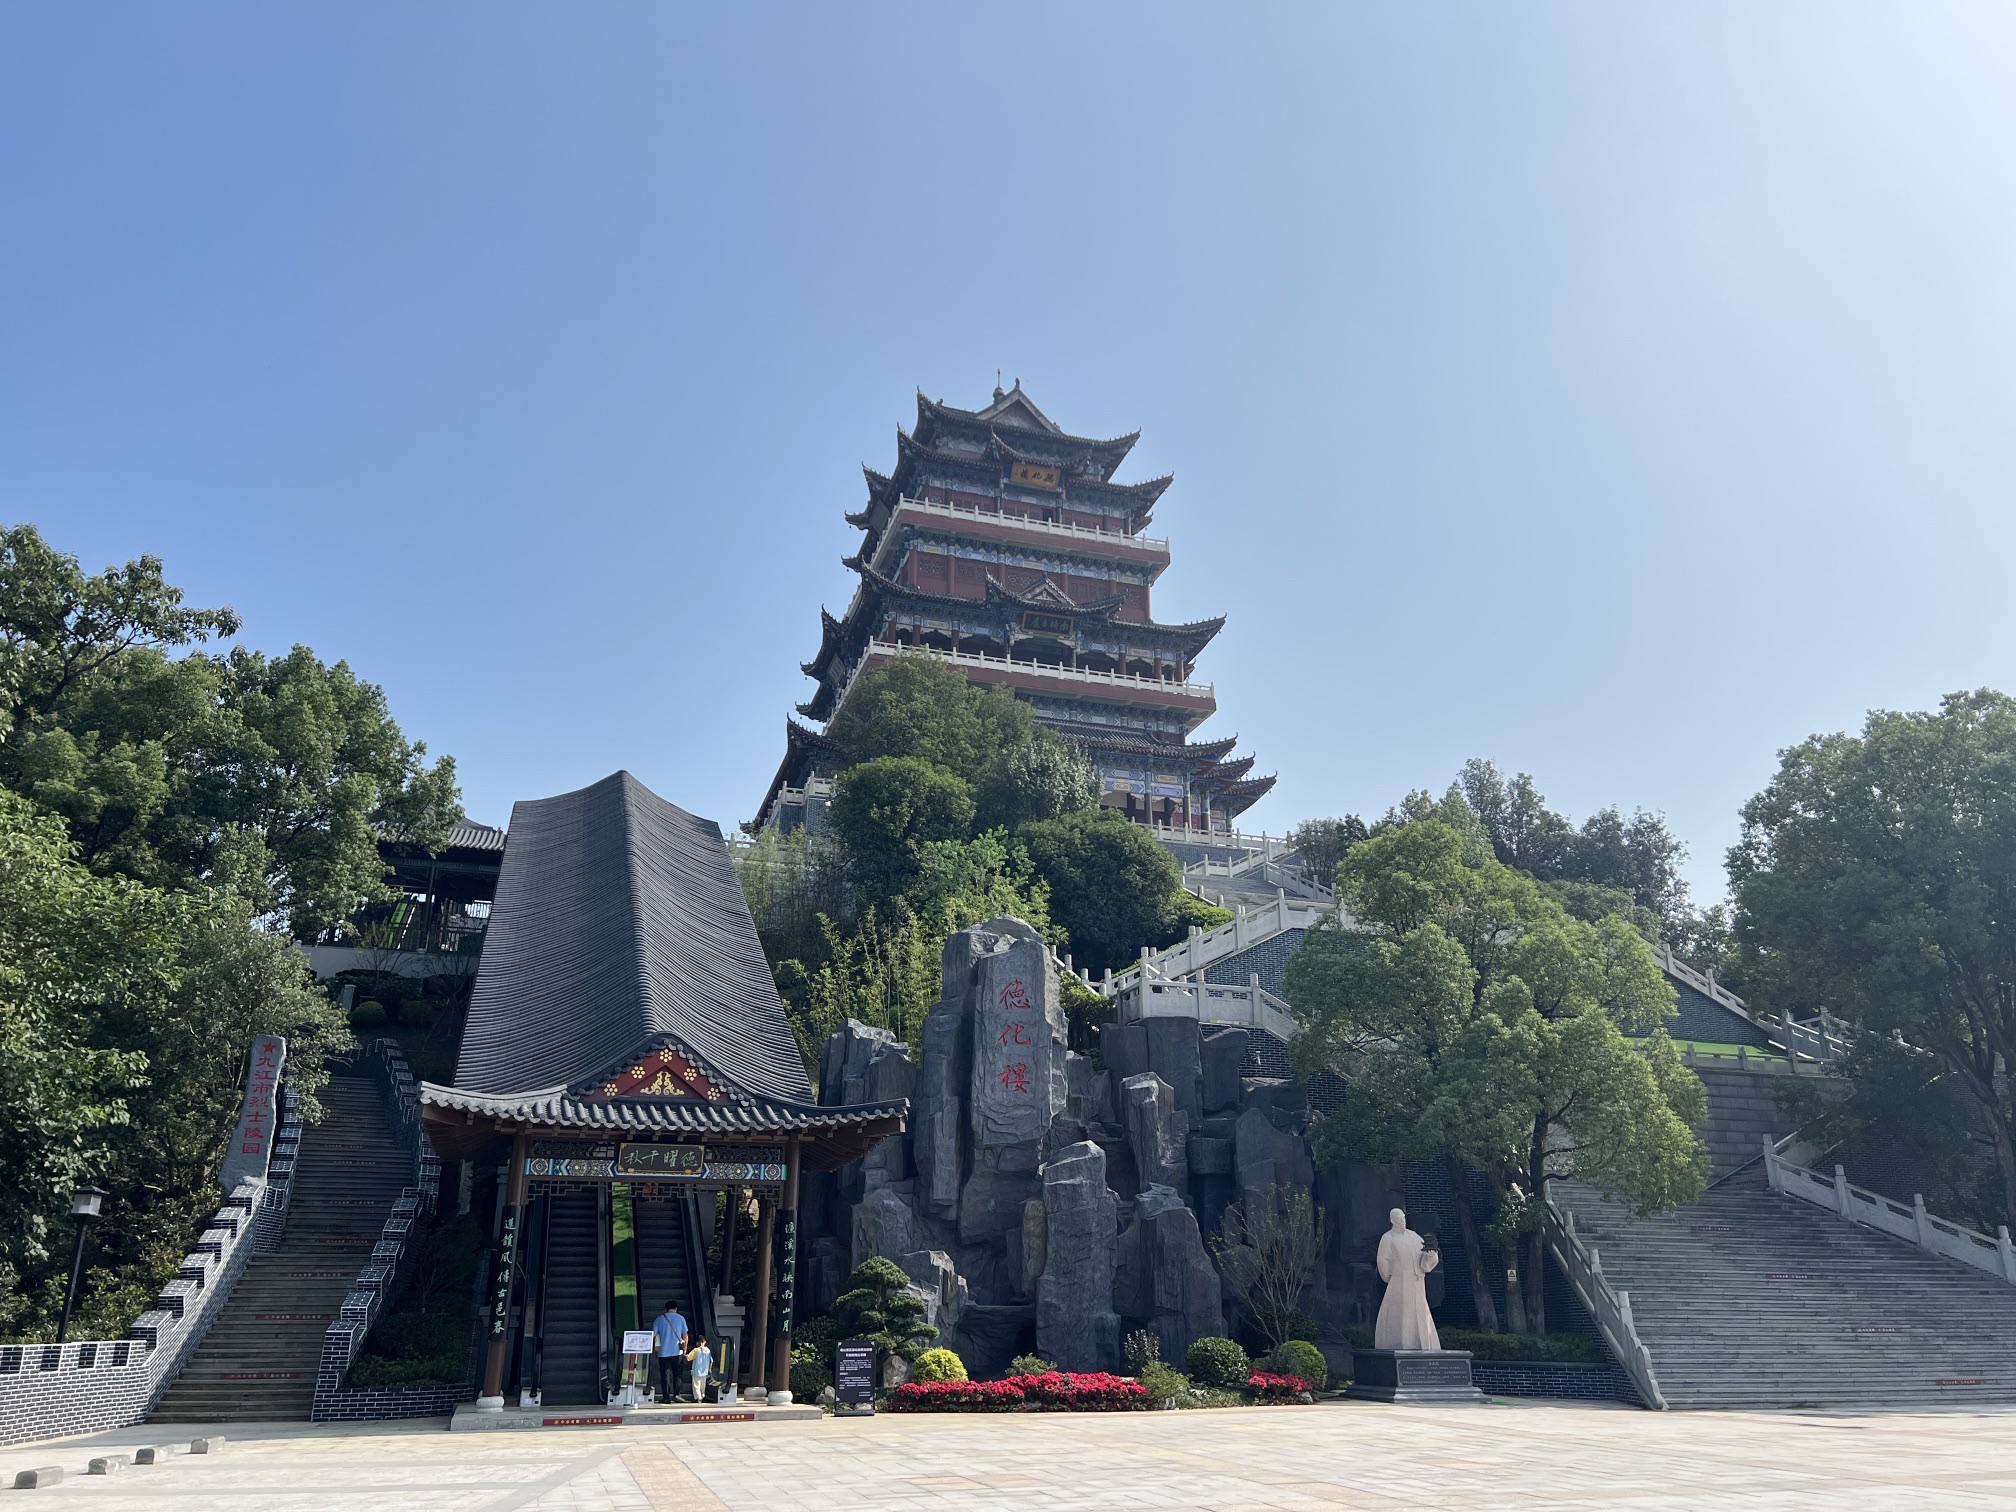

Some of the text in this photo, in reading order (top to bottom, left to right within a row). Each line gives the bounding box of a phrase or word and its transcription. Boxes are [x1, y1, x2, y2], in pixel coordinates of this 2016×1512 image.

[242, 1057, 276, 1154] 九江市烈士陵园
